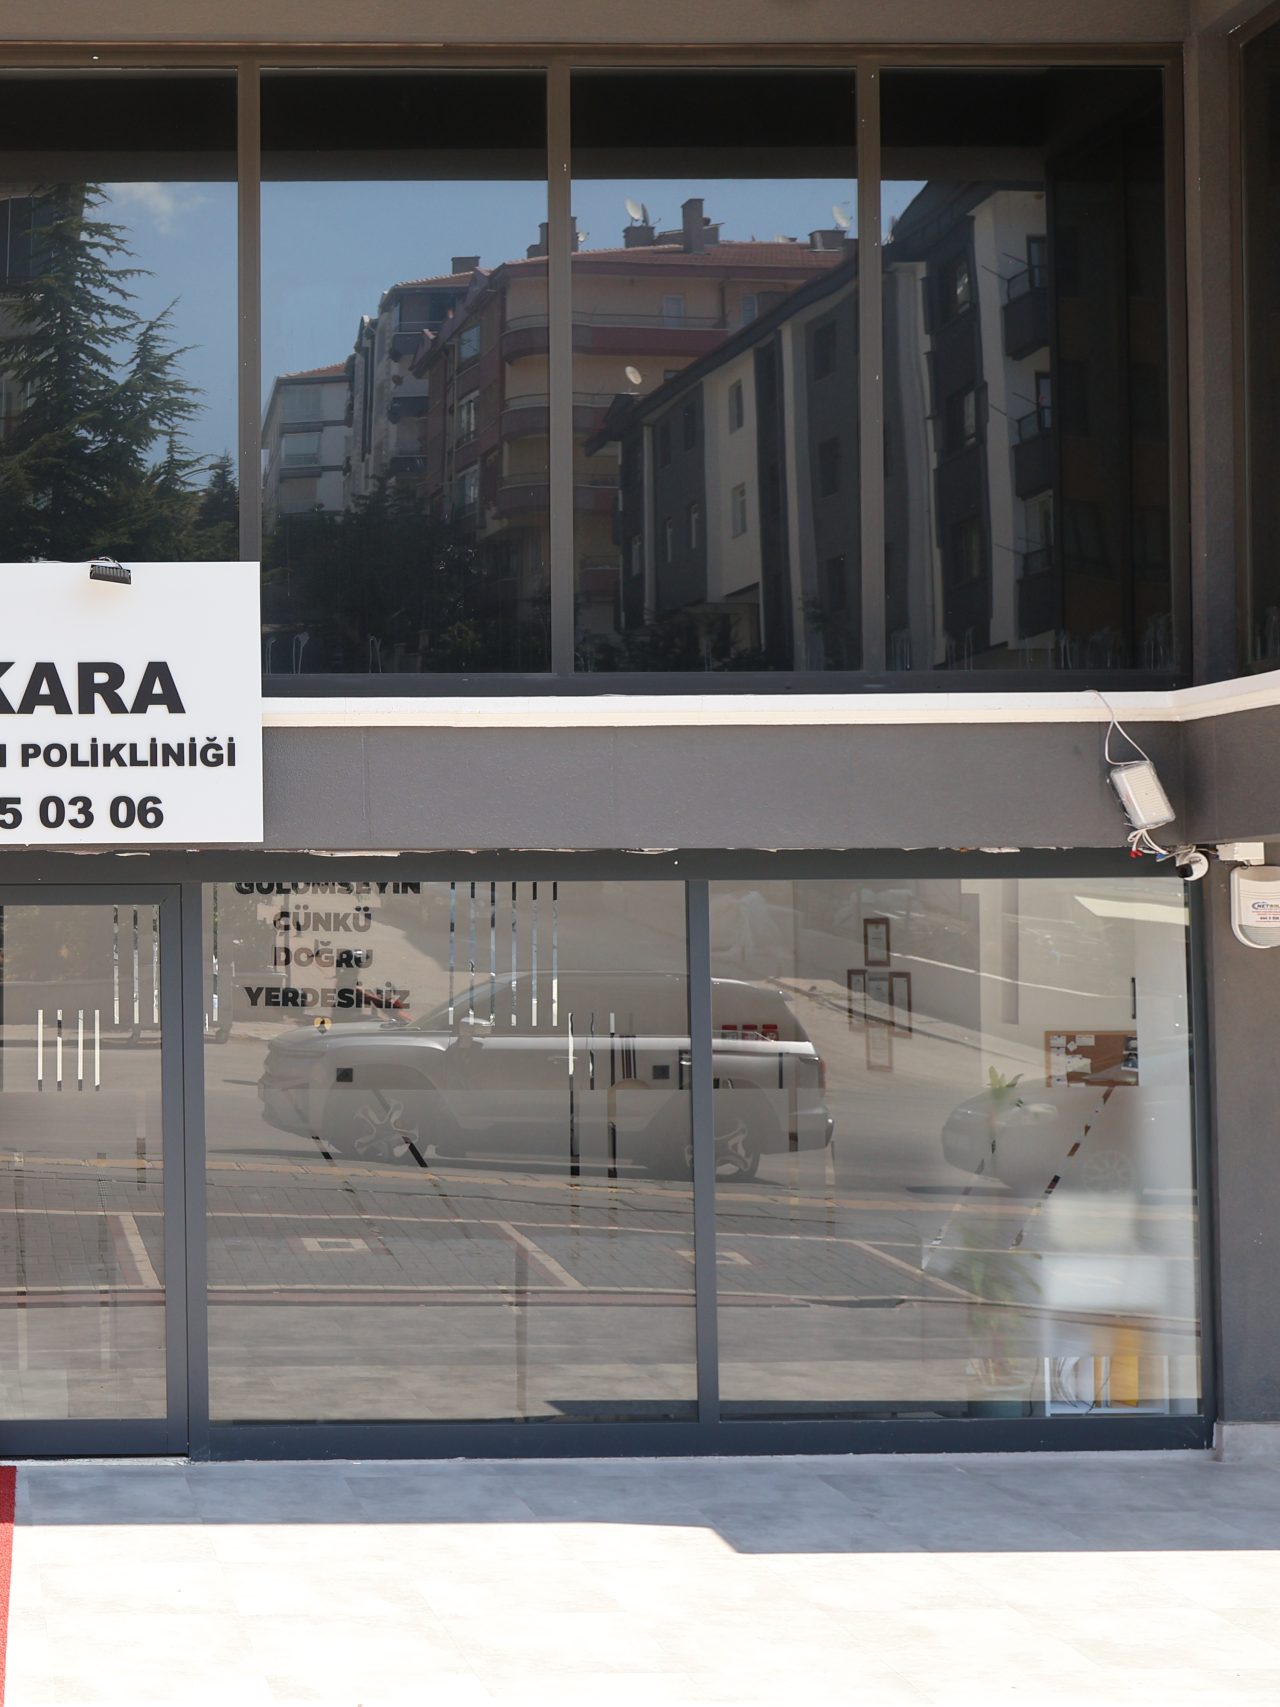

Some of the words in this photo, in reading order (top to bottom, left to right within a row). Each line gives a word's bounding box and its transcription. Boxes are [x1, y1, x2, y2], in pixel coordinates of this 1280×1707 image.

[21, 736, 236, 768] POLİKLİNİĞİ
[39, 795, 95, 829] 03
[109, 795, 164, 829] 06
[273, 904, 372, 936] ÇÜNKÜ
[274, 940, 374, 969] DOĞRU
[244, 982, 410, 1009] YERDESİNİZ
